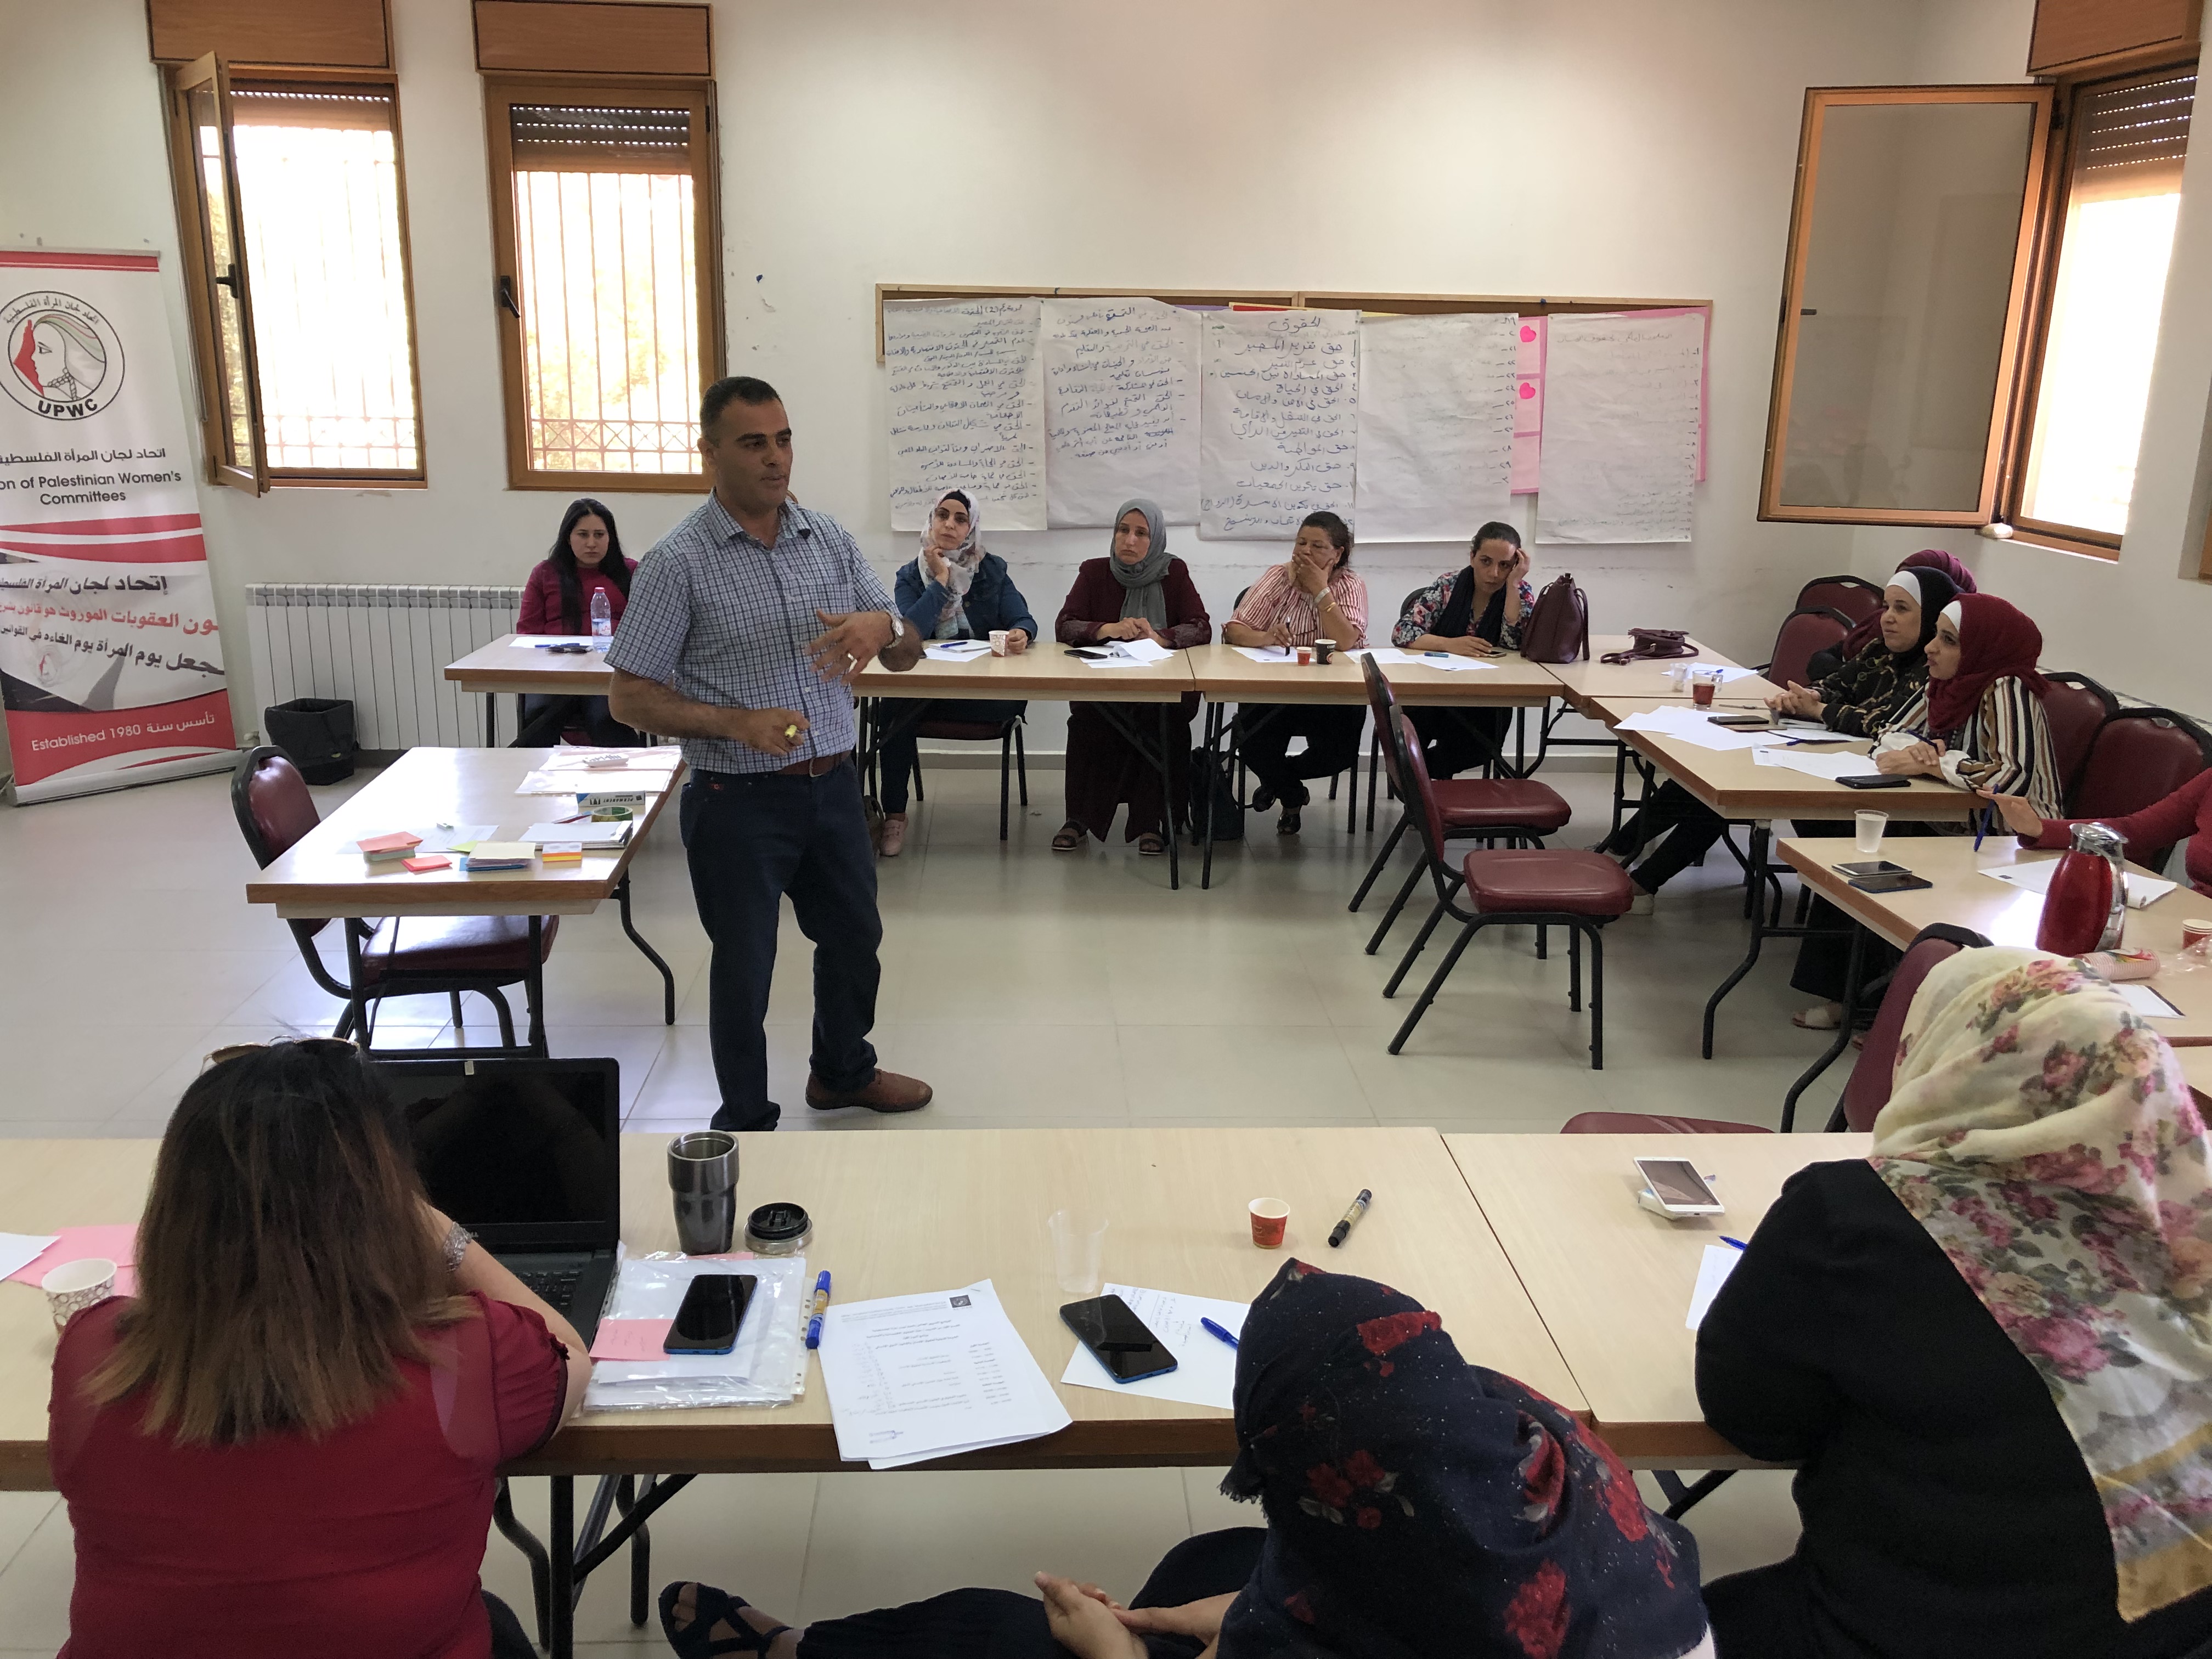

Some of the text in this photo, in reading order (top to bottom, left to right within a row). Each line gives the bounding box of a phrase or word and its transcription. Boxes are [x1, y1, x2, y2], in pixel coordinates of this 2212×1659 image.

[1268, 316, 1320, 333] الحقوق
[1321, 343, 1342, 354] حق
[1311, 385, 1318, 396] في
[1322, 383, 1343, 394] الحق
[38, 399, 98, 417] UPWC
[1318, 397, 1339, 408] الحق
[1323, 414, 1341, 423] الحق
[64, 448, 98, 463] المرأة
[101, 448, 132, 463] لجان
[136, 448, 166, 459] اتحاد
[1327, 444, 1348, 454] حق
[20, 476, 35, 489] of
[38, 473, 115, 489] Palestinian
[117, 470, 182, 484] Women's
[1319, 482, 1341, 492] حق
[40, 491, 127, 505] Committees
[35, 576, 69, 594] المرأة
[70, 575, 110, 594] لجان
[114, 575, 170, 596] إتحاد
[18, 603, 42, 615] قانون
[44, 606, 56, 618] هو
[58, 605, 108, 623] الموروث
[111, 610, 179, 630] العقوبات
[29, 629, 42, 641] في
[75, 639, 94, 653] يوم
[96, 637, 133, 659] المرأة
[136, 651, 162, 668] يوم
[166, 652, 225, 679] جعل
[31, 712, 215, 752] Established 1980 سنة تأسس
